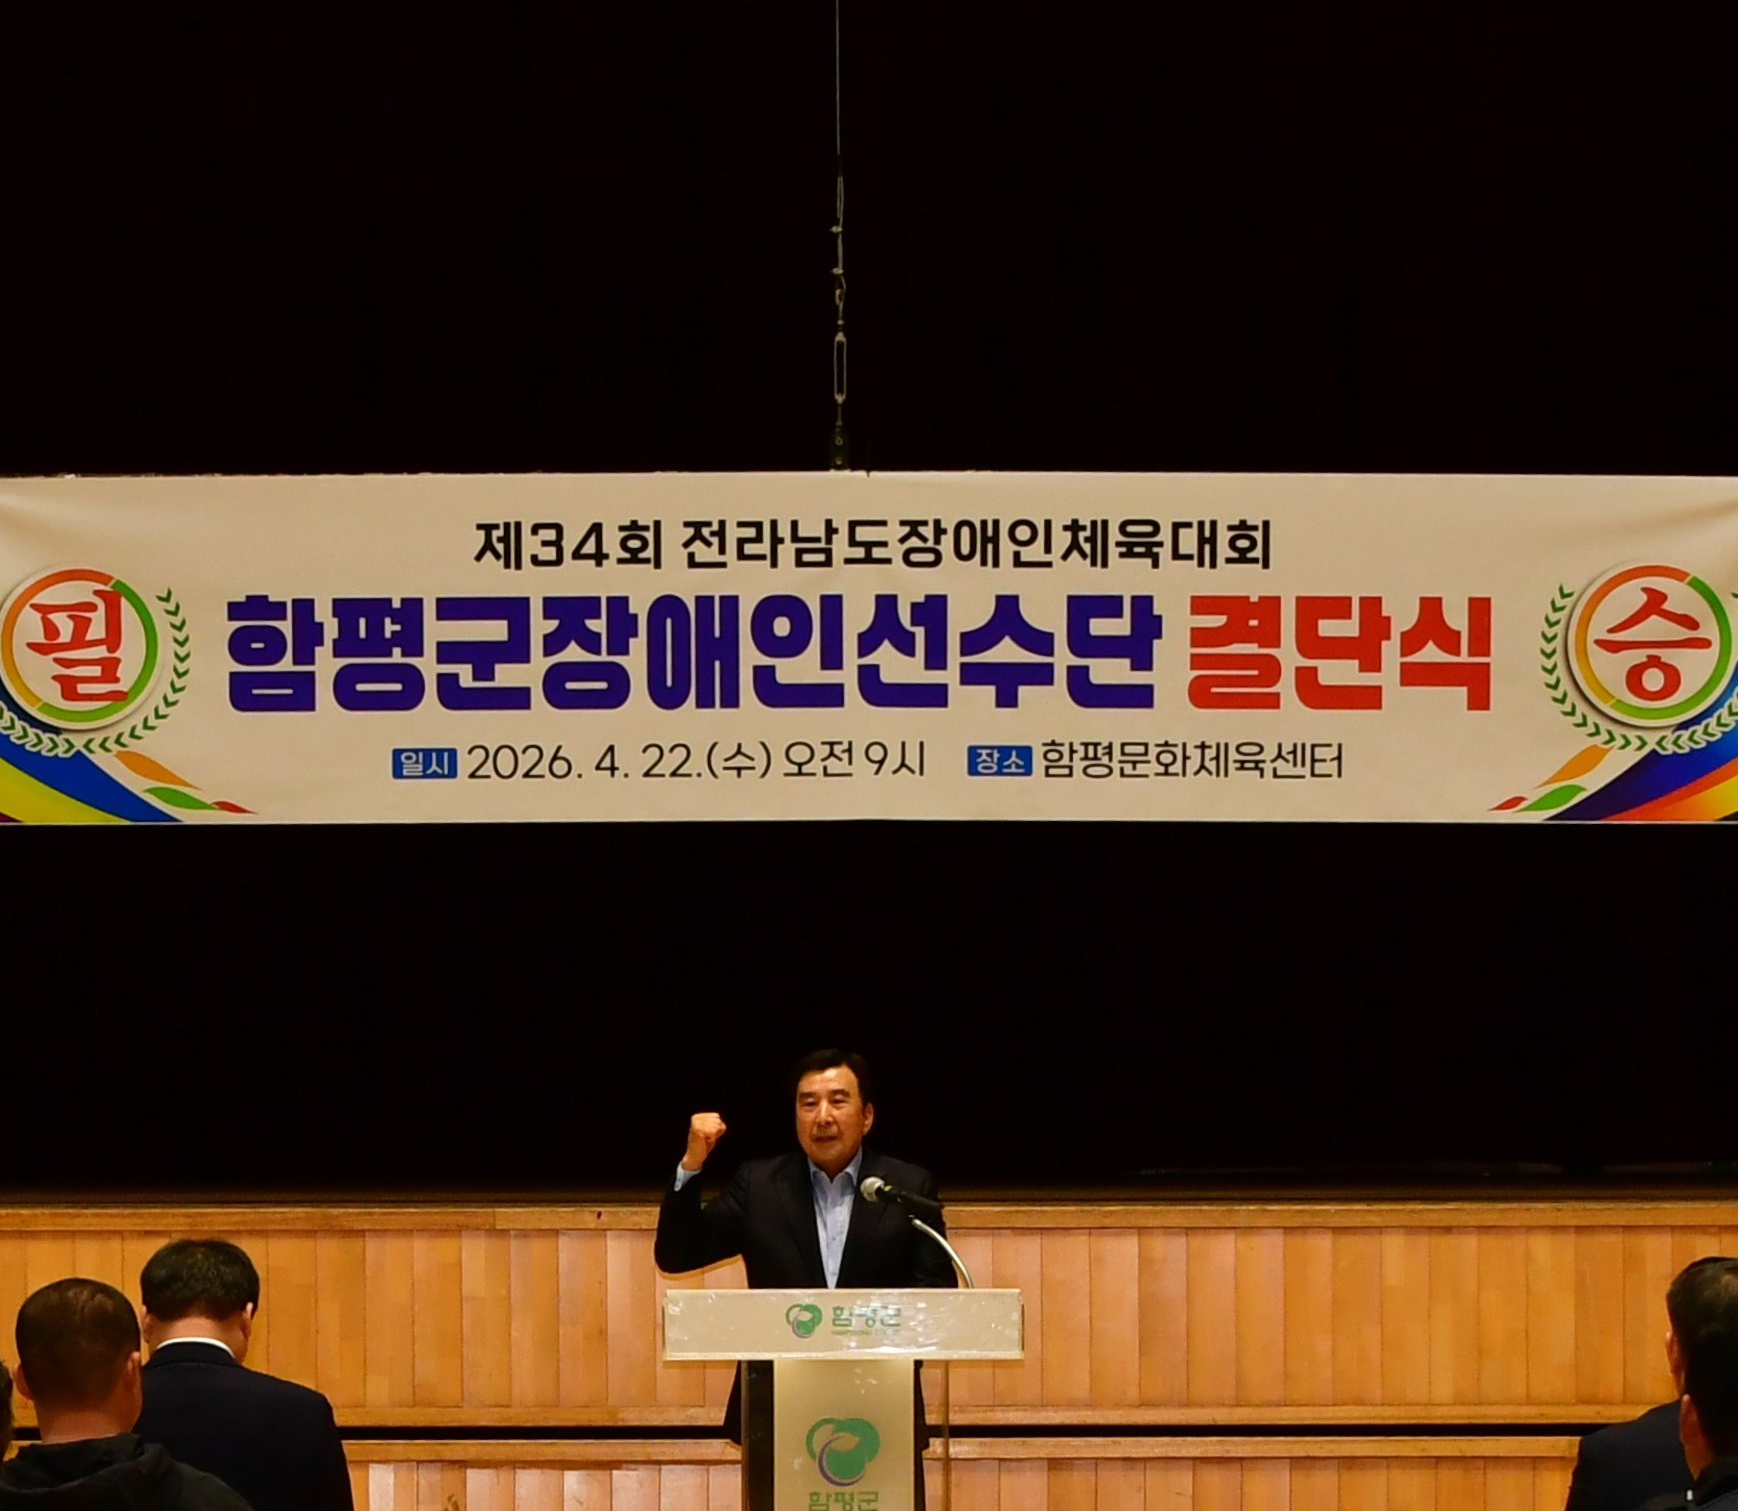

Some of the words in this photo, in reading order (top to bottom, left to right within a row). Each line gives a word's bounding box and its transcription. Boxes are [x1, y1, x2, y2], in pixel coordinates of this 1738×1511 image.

[473, 518, 663, 571] 제34회
[681, 517, 1272, 571] 전라남도장애인체육대회
[25, 588, 125, 703] 필
[226, 593, 1162, 713] 함평군장애인선수단
[1186, 594, 1493, 712] 결단식
[1593, 586, 1713, 702] 승
[399, 751, 452, 777] 일시
[467, 744, 583, 780] 2026.
[594, 744, 630, 779] 4.
[783, 740, 854, 778] 오전
[864, 740, 926, 777] 9시
[974, 747, 1028, 776] 장소
[1041, 739, 1344, 780] 함평문화체육센터
